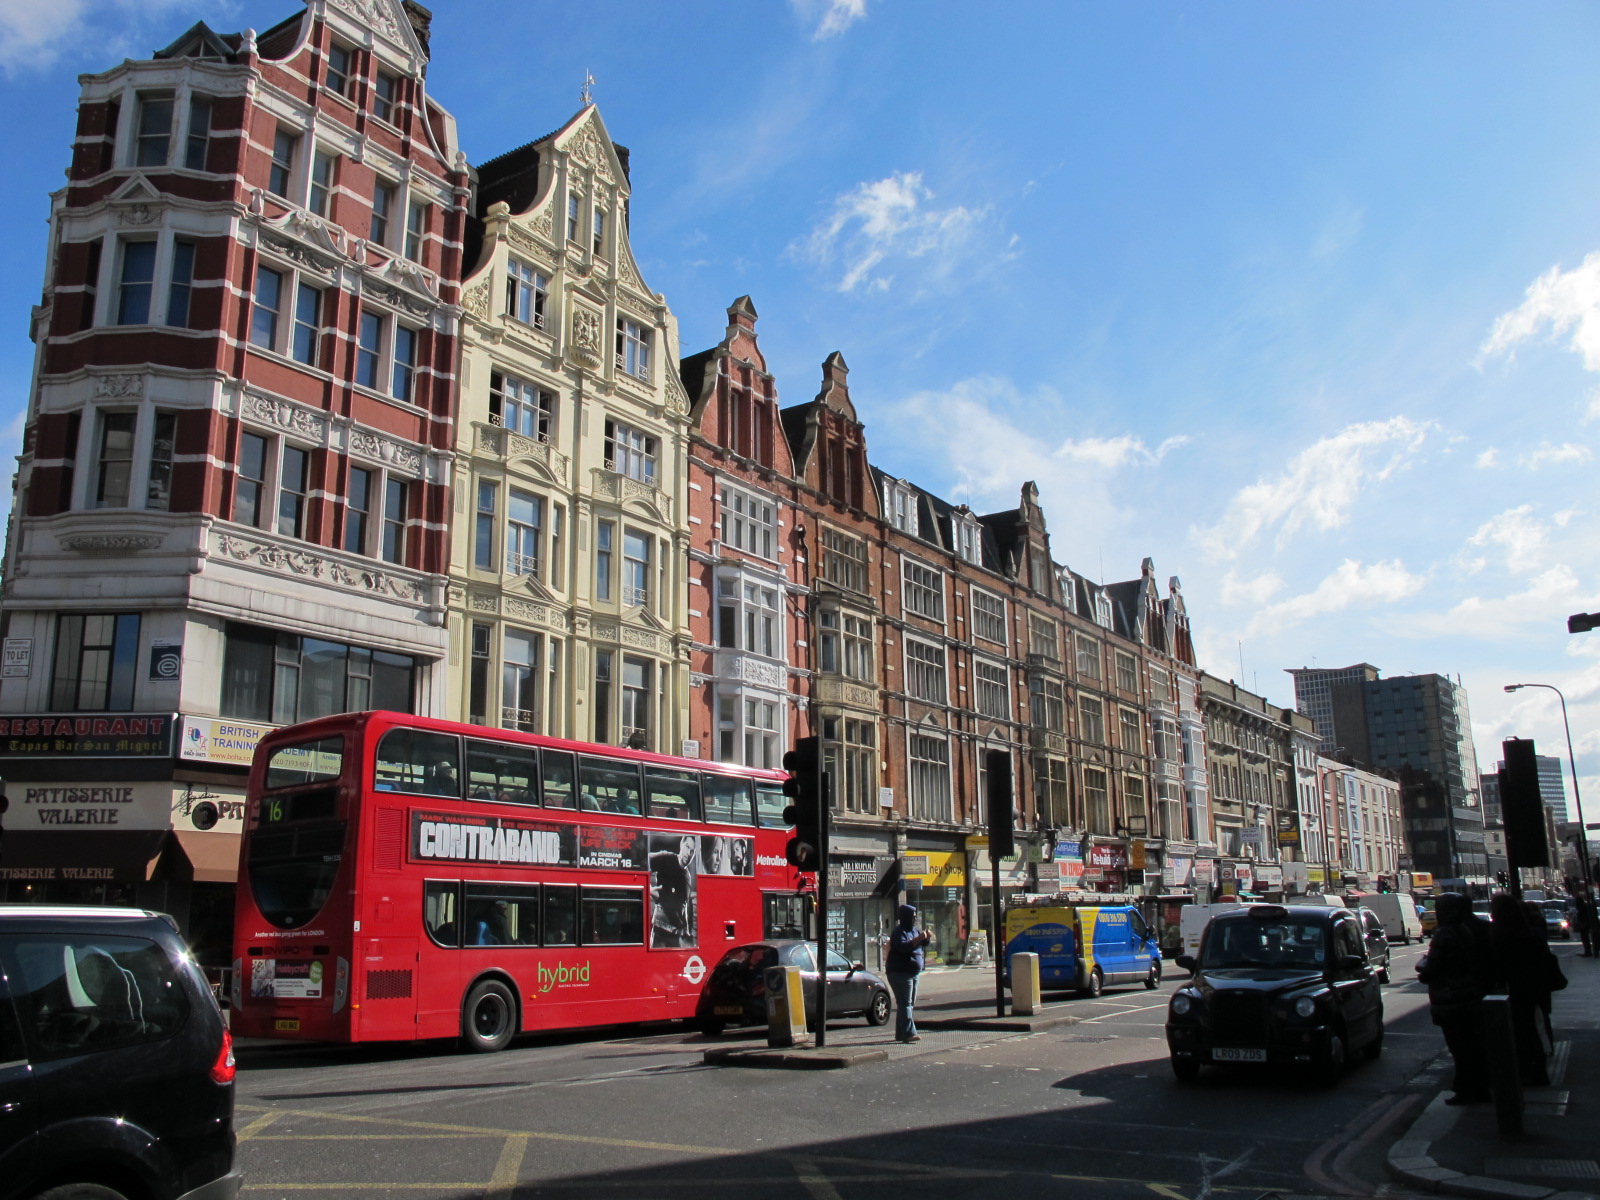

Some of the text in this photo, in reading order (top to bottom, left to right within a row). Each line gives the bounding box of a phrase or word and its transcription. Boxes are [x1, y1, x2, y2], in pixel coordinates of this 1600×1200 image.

[7, 651, 29, 660] TO LET
[0, 718, 164, 736] RESTAURANT
[219, 726, 259, 739] BRITISH
[9, 740, 49, 752] Tapas
[25, 788, 134, 804] PATISSERIE
[38, 809, 118, 825] VALERIE
[269, 800, 282, 822] 16
[420, 814, 560, 832] MARK WAHLBERG ATE BECKINSALE
[420, 821, 561, 864] CONTRABAND
[580, 856, 632, 868] MARCH 16
[756, 854, 788, 867] Metroline
[62, 868, 114, 879] VALERIE
[844, 873, 877, 883] PROPERTIES
[276, 964, 310, 974] Hobbycraft
[537, 960, 590, 992] hybrid
[1216, 1050, 1262, 1059] LR09 ZDS
